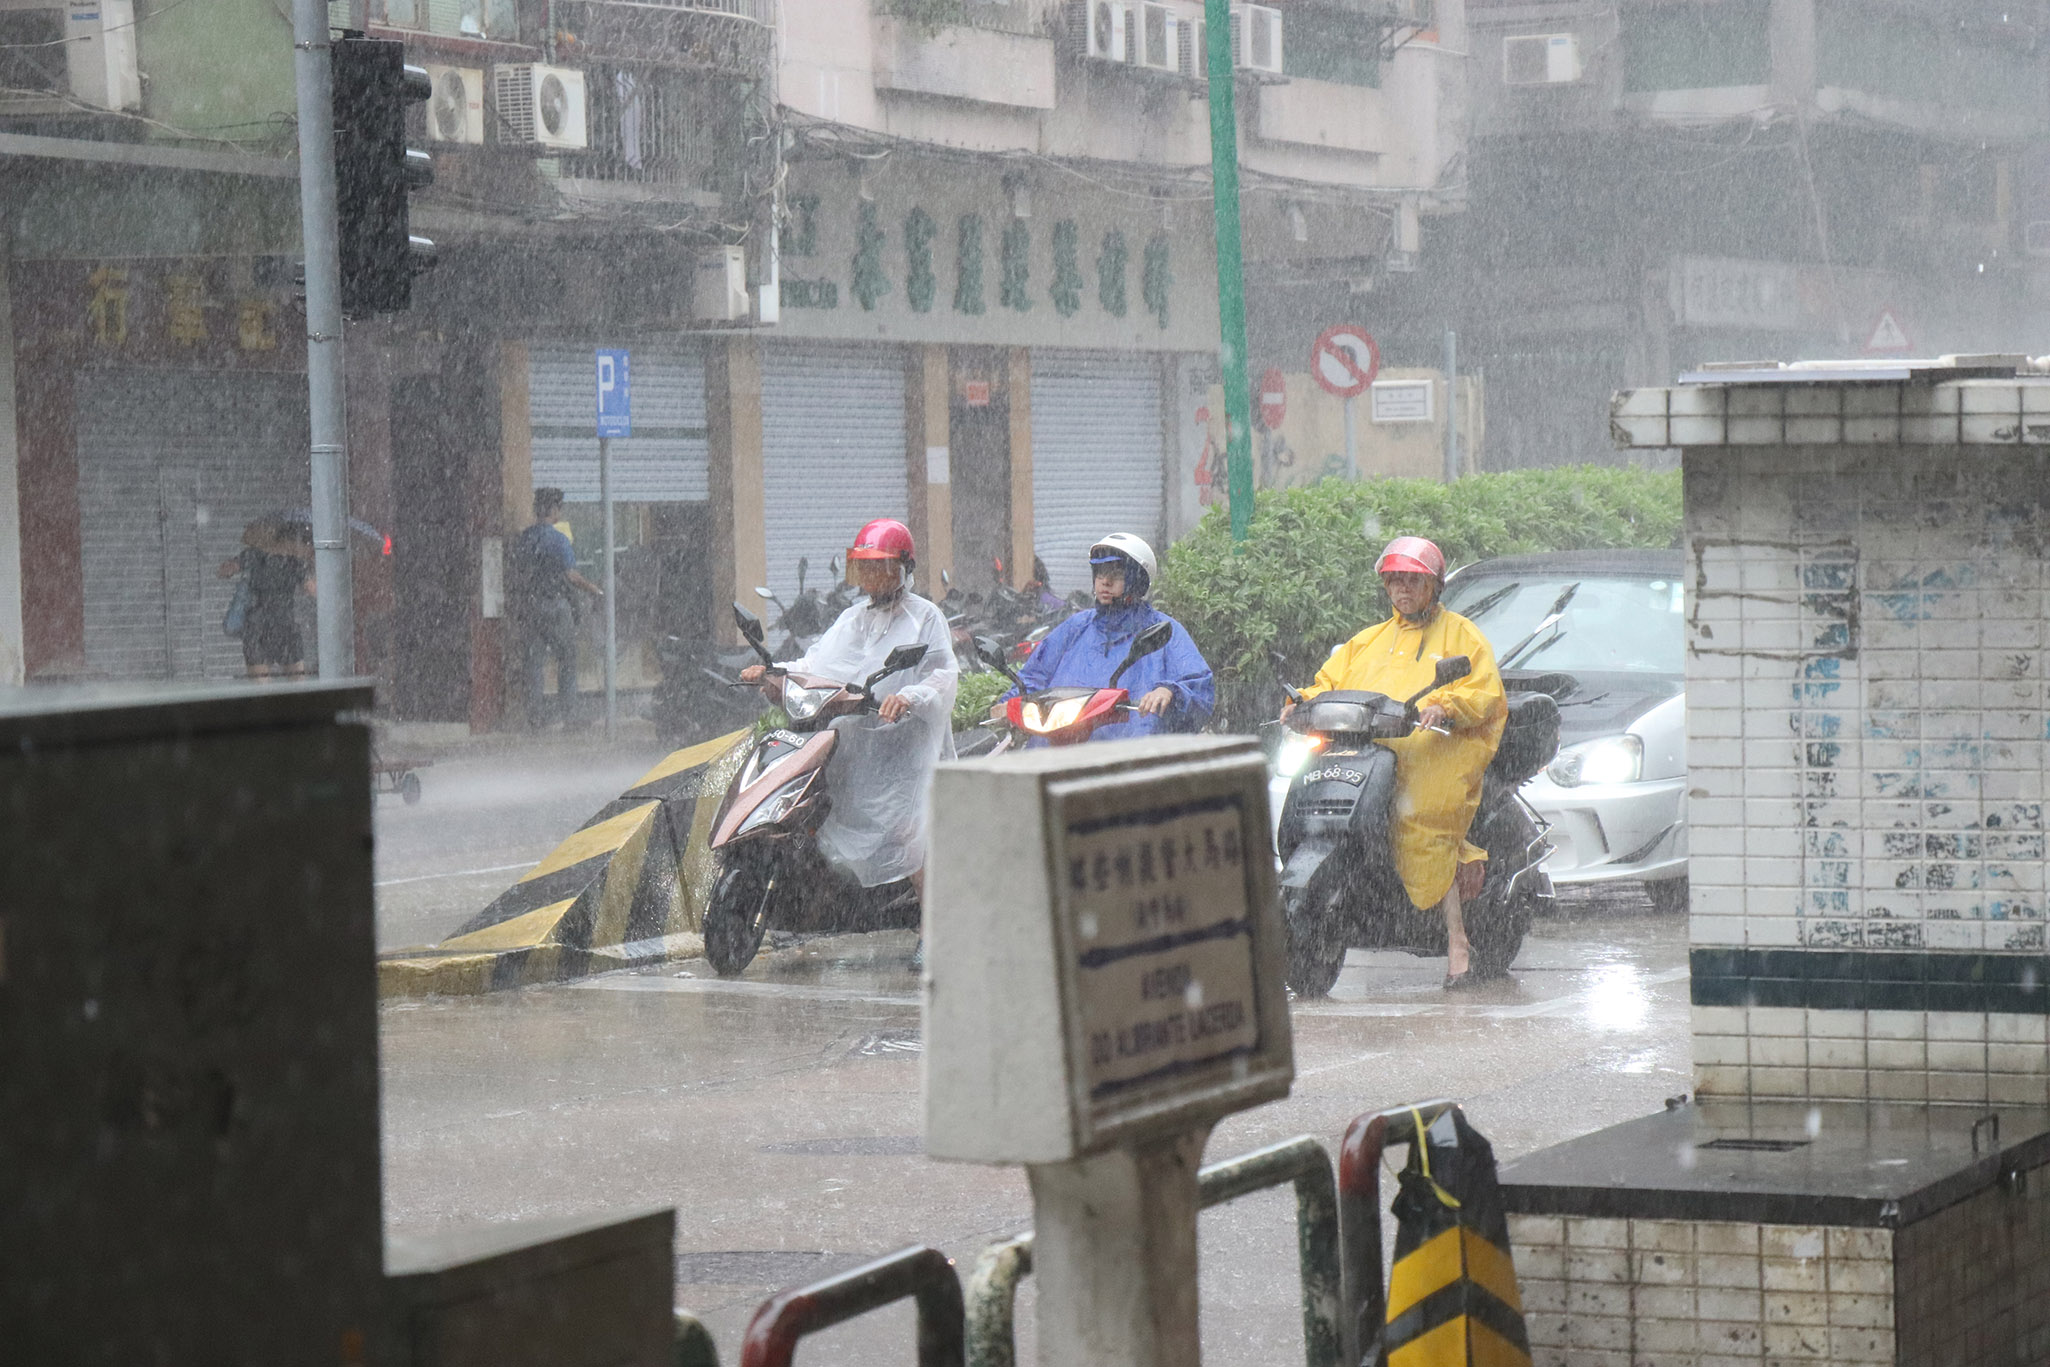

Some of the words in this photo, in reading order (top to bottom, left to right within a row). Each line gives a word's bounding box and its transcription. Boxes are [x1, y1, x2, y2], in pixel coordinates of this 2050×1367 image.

[598, 356, 615, 413] P
[760, 729, 805, 746] -50-60
[1303, 767, 1363, 785] MB-68-95
